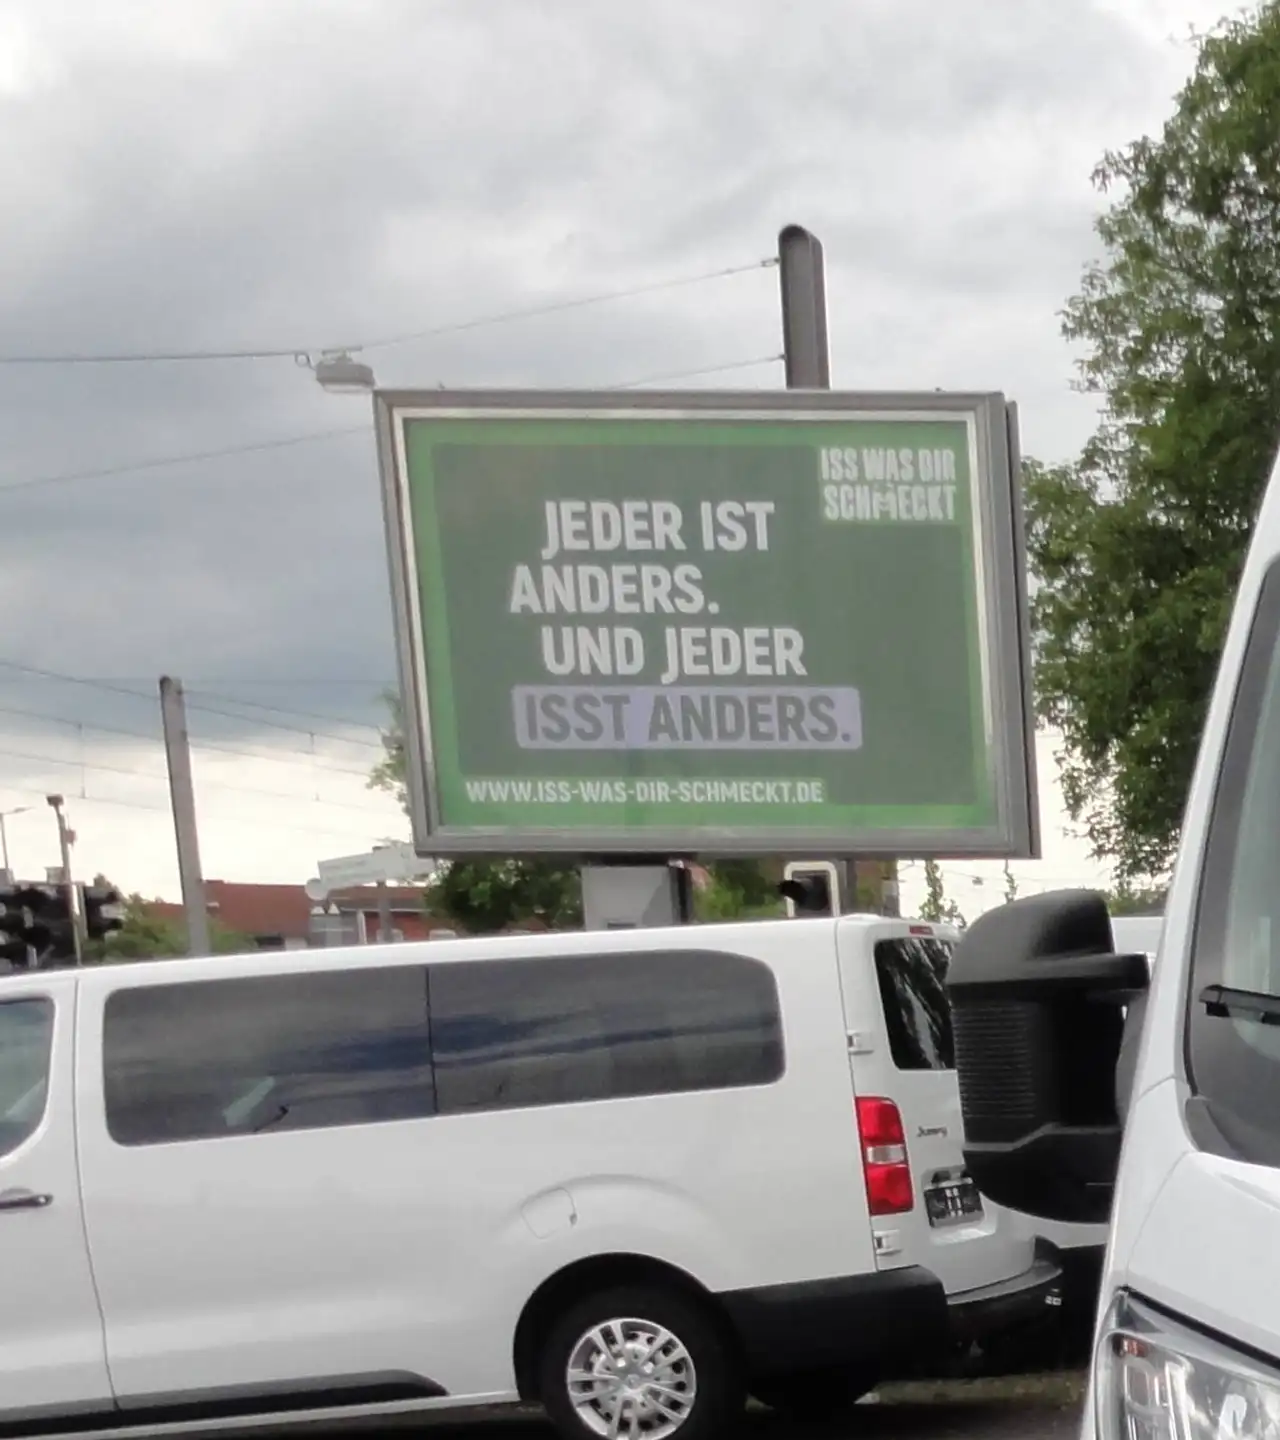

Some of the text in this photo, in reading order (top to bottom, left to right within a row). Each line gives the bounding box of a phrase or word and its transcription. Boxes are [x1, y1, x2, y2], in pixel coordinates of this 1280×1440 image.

[821, 448, 956, 481] ISS WAS DIR
[823, 484, 957, 520] SCHMECKT
[541, 500, 775, 560] JEDER IST
[510, 563, 720, 614] ANDERS.
[541, 625, 808, 685] UND JEDER
[524, 694, 851, 742] ISST ANDERS.
[465, 779, 825, 804] WWW.ISS-WAS-DIR-SCHMECKT.DE
